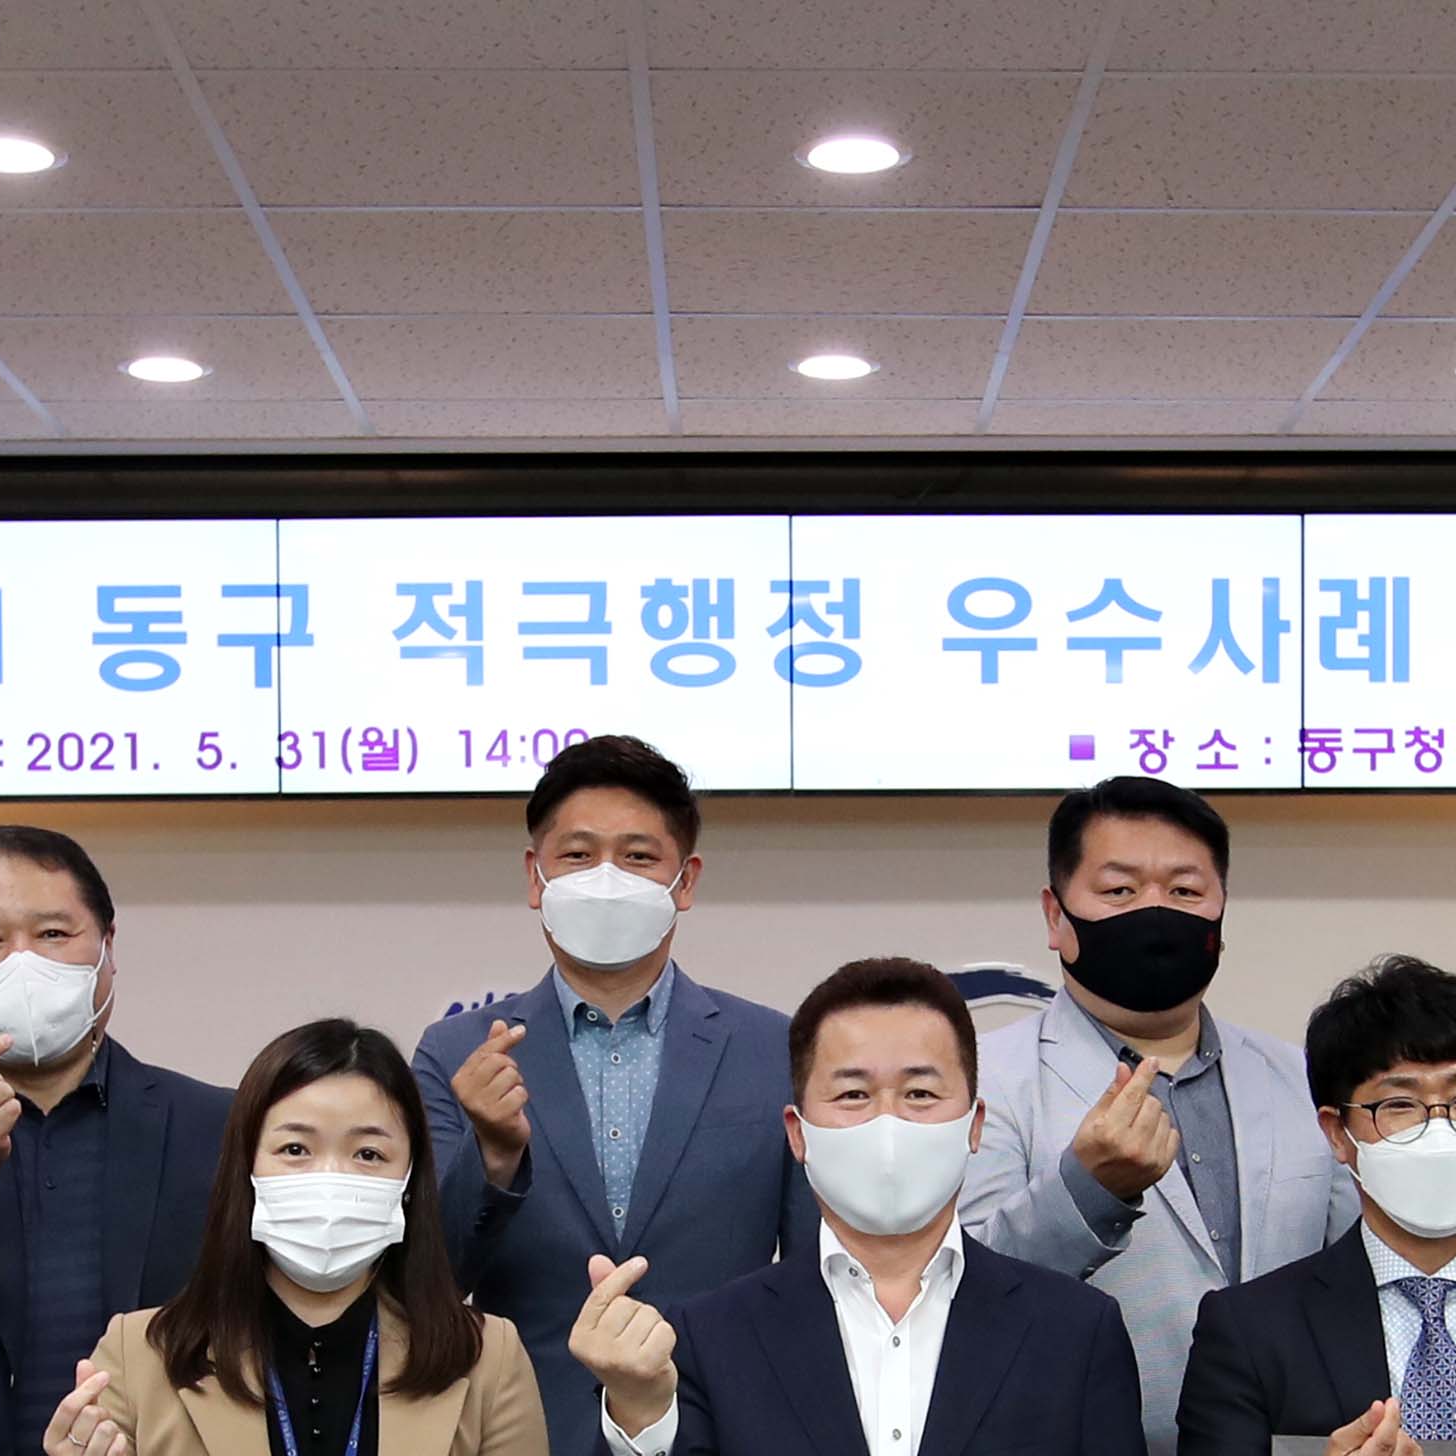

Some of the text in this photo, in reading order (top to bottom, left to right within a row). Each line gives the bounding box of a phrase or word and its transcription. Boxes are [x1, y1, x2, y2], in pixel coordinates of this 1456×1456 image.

[91, 583, 315, 692] 동구
[391, 577, 863, 688] 적극행정
[941, 576, 1410, 685] 우수사례
[195, 731, 238, 770] 5.
[275, 725, 419, 774] 31(월)
[1129, 728, 1175, 774] 장
[1297, 725, 1446, 774] 동구청
